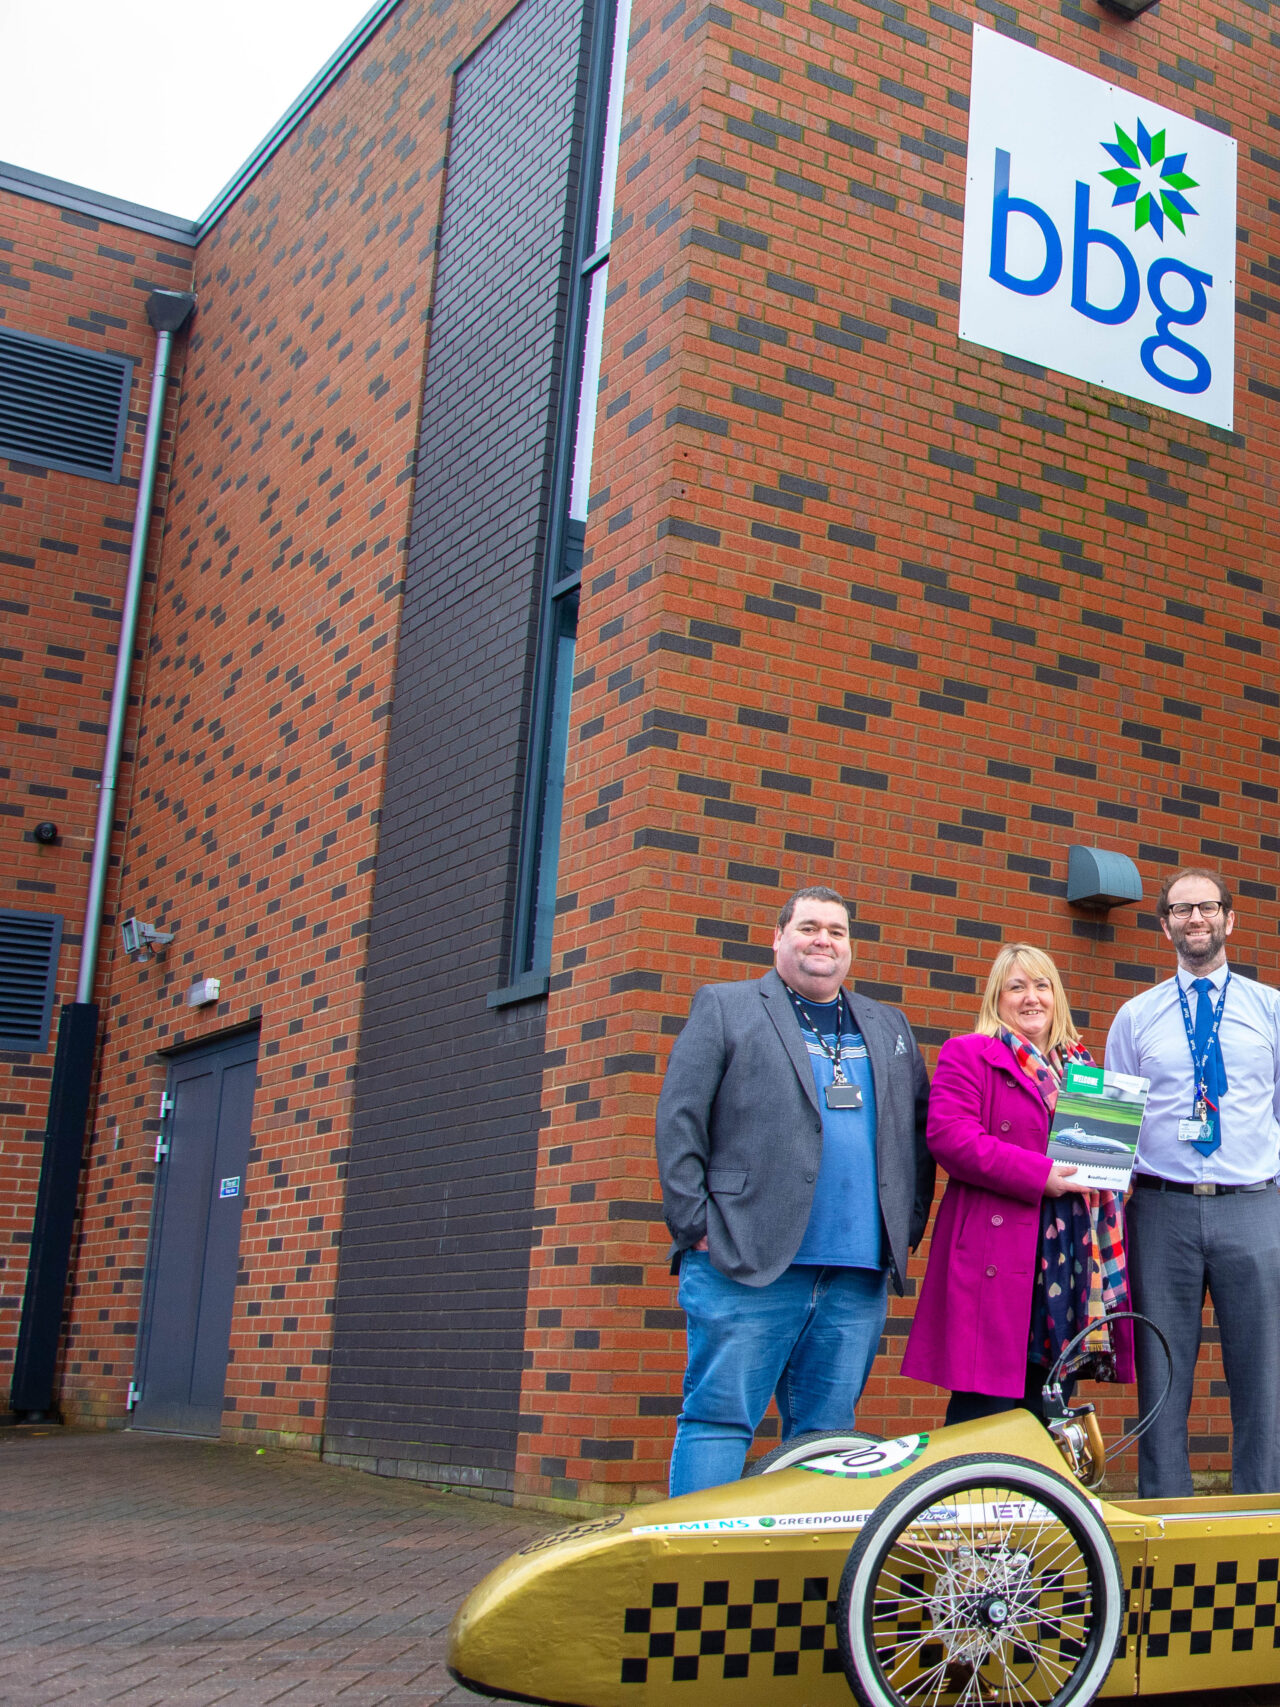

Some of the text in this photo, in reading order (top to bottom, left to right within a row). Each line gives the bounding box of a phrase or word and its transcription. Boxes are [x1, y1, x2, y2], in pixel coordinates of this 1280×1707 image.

[989, 146, 1213, 395] bbg
[992, 1503, 1026, 1519] IET
[639, 1519, 750, 1531] SIEMENS
